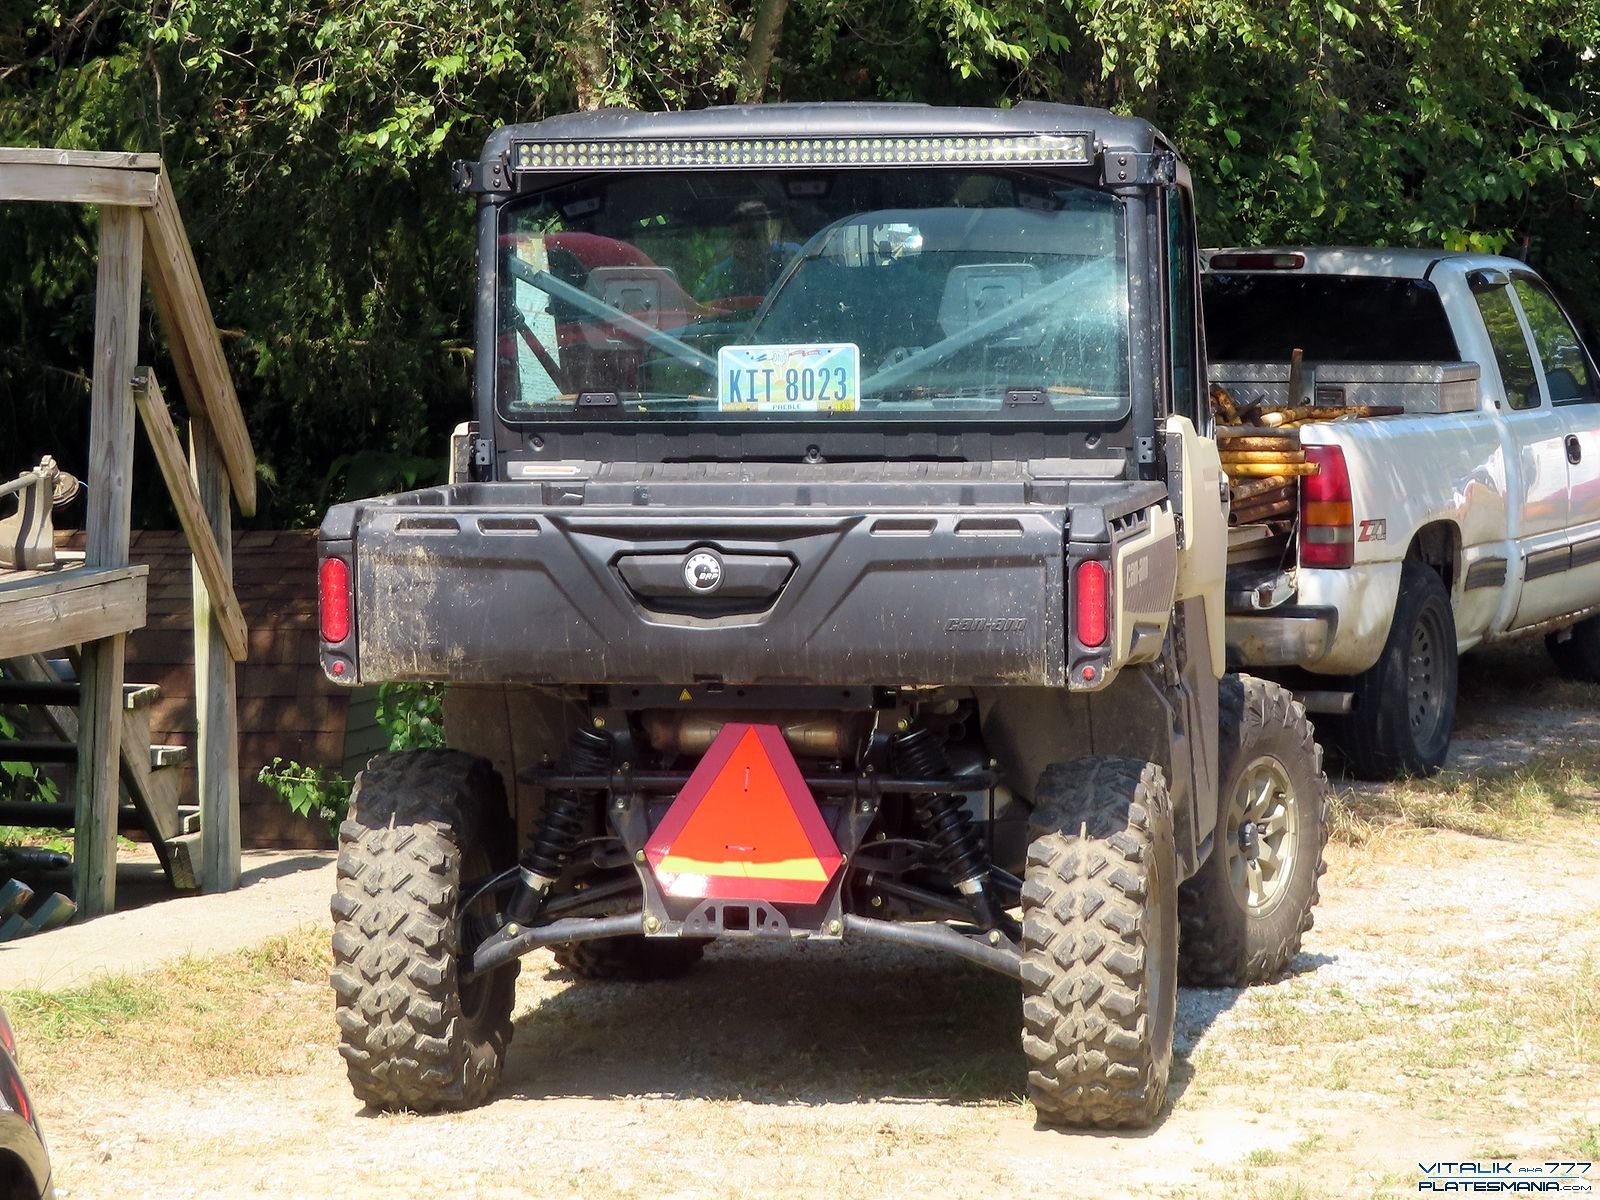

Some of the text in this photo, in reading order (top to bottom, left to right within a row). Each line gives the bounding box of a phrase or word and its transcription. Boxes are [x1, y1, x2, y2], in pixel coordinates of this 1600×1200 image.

[729, 367, 847, 403] KIT 8023
[1358, 518, 1386, 542] Z71
